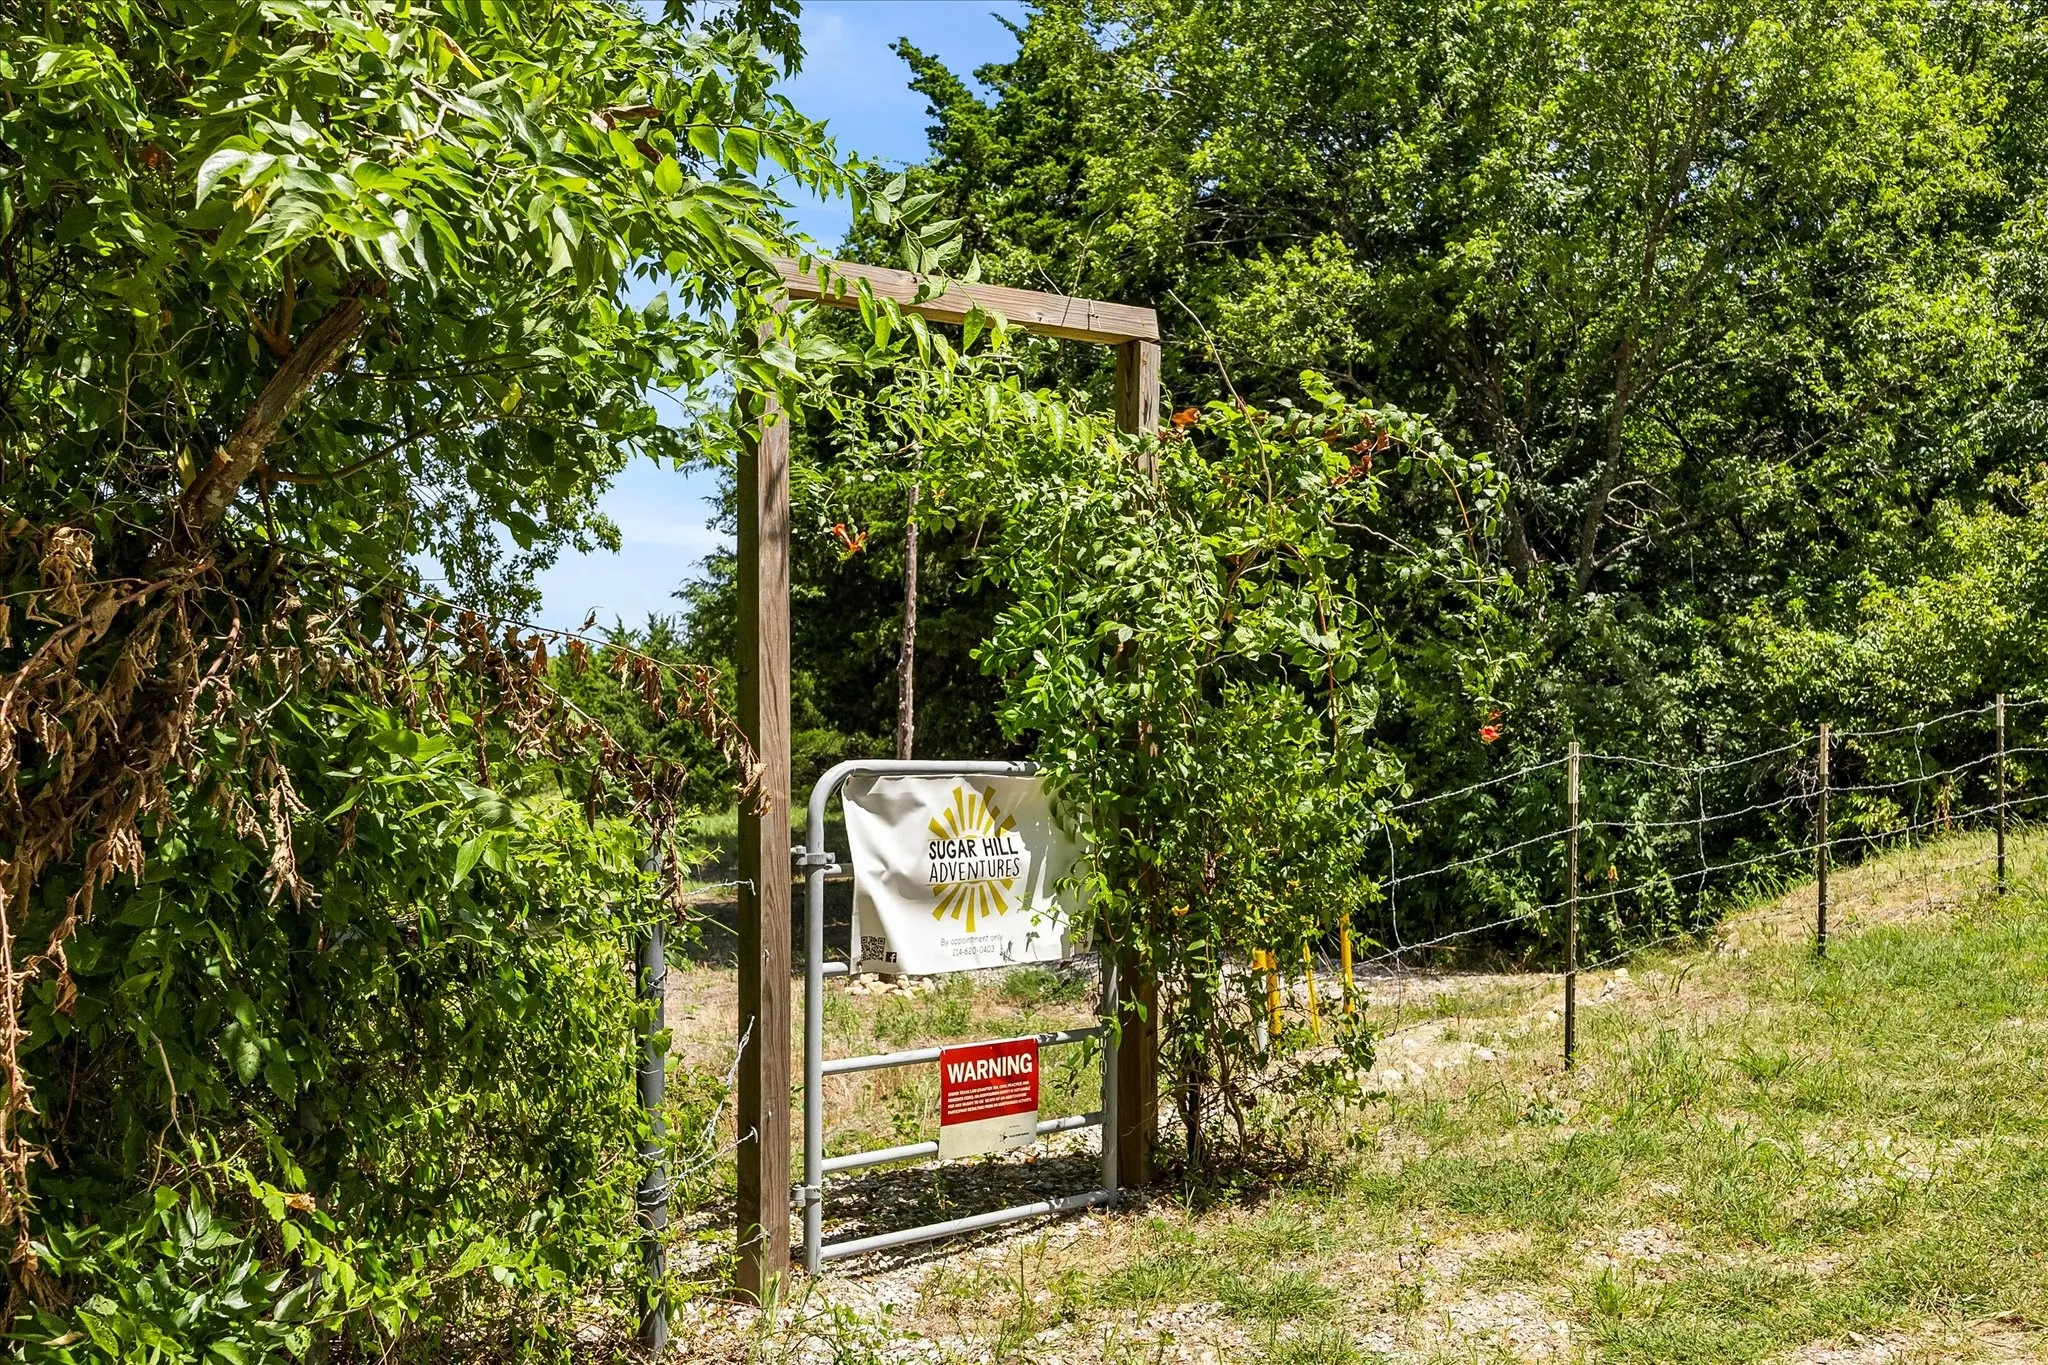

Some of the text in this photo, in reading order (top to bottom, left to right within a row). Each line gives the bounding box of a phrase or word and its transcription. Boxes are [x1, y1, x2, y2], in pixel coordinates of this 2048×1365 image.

[928, 837, 1019, 860] SUGAR HILL
[929, 858, 1020, 883] ADVENTURES
[940, 933, 1003, 947] By appointment only
[947, 1053, 1033, 1084] WARNING
